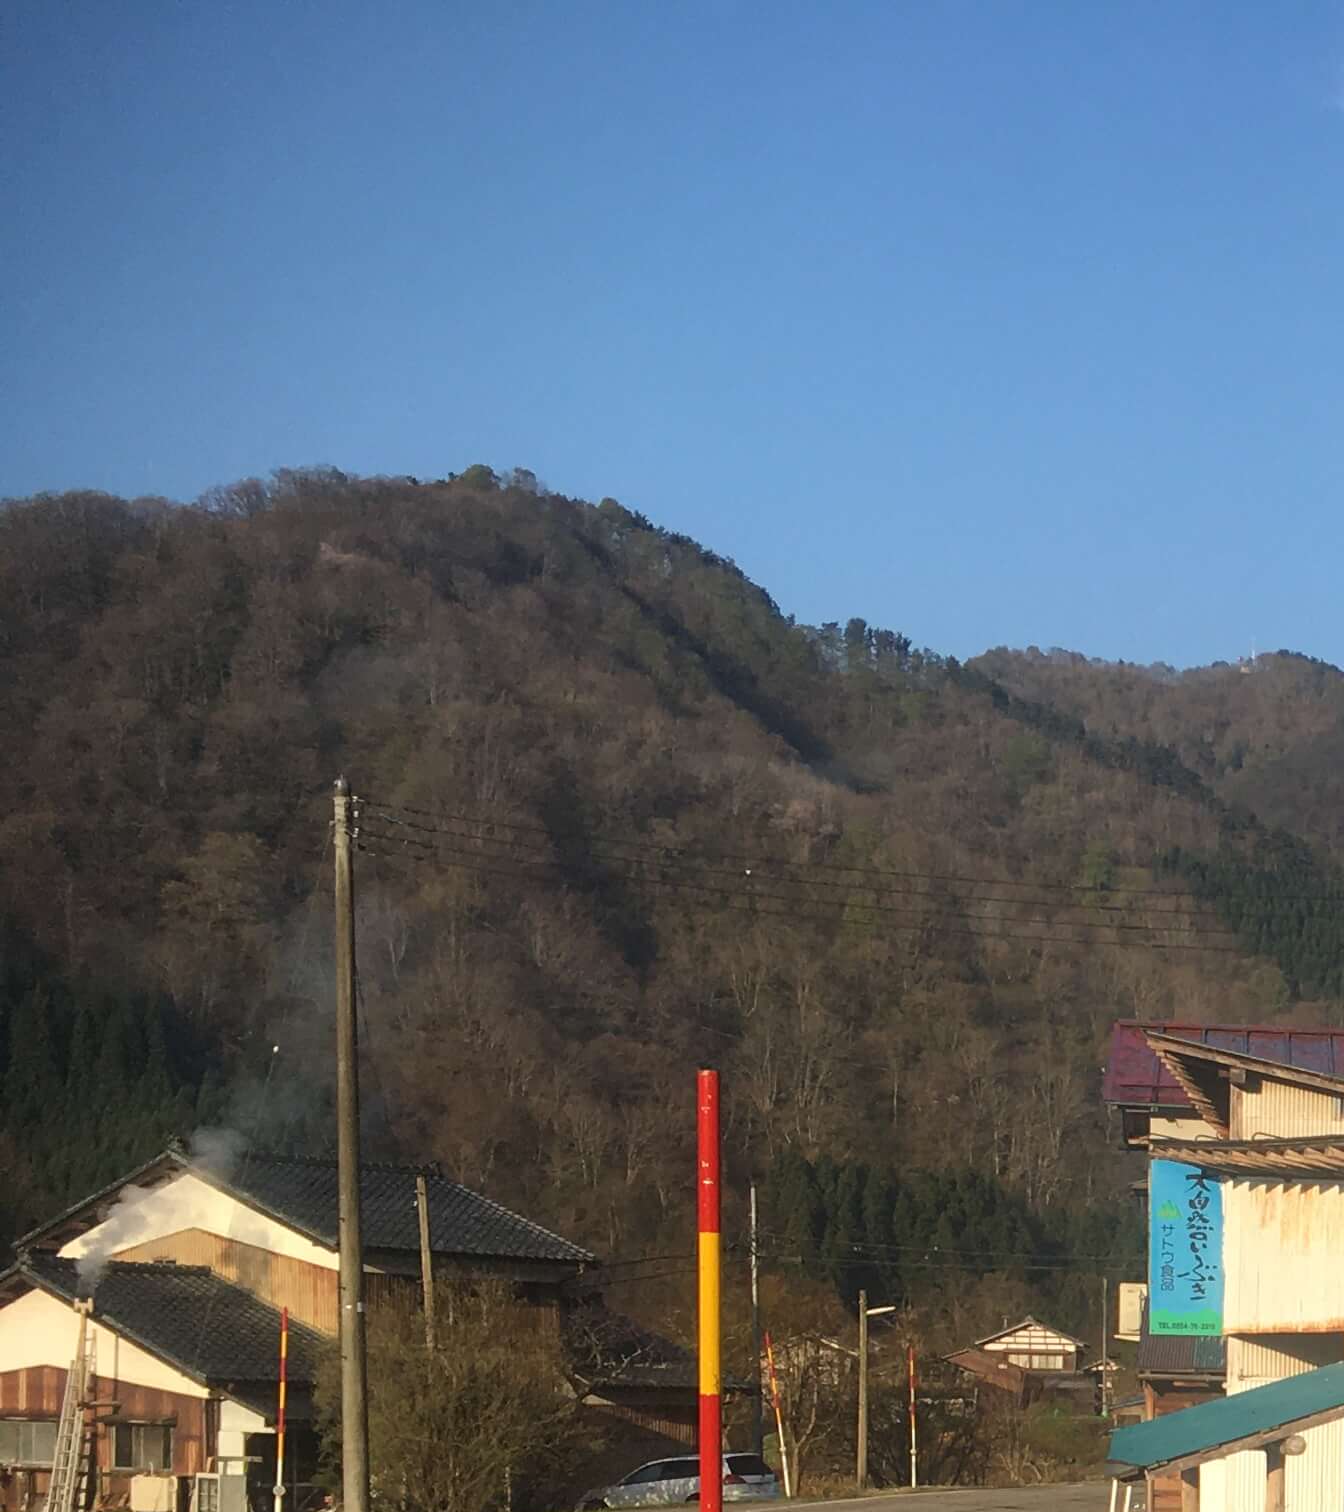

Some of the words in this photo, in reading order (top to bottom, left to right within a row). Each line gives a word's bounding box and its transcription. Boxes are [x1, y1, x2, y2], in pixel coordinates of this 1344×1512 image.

[1160, 1223, 1176, 1292] サトウ食品
[1177, 1169, 1217, 1300] 大自然のいぶき
